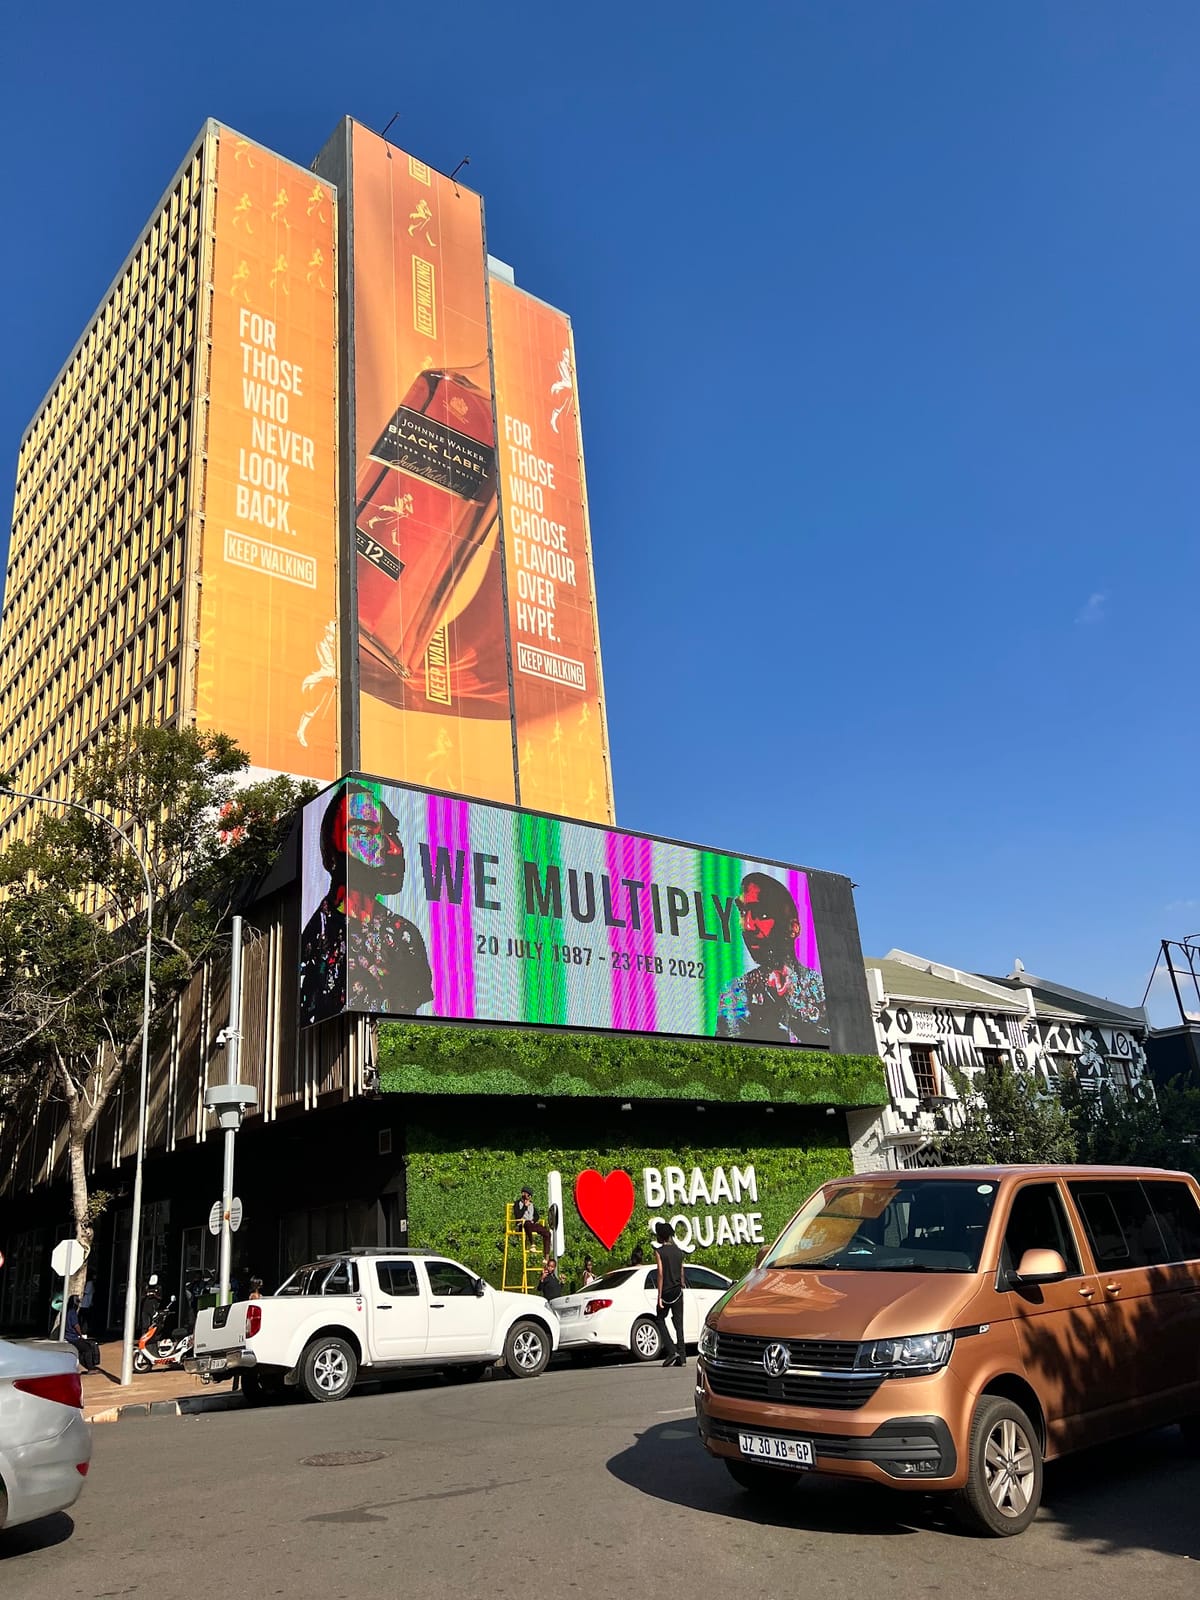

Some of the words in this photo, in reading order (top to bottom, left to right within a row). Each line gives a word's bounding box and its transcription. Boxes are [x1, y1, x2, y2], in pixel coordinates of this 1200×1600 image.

[239, 307, 276, 351] FOR
[240, 342, 304, 396] THOSE
[242, 377, 289, 424] WHO
[251, 416, 315, 471] NEVER
[388, 424, 439, 453] BLACK
[443, 449, 489, 478] LABEL
[402, 418, 445, 443] JOHNNIE
[504, 414, 532, 450] FOR
[239, 448, 290, 497] LOOK
[508, 445, 556, 490] THOSE
[236, 484, 297, 536] BACK.
[509, 474, 544, 514] WHO
[364, 540, 384, 564] 12
[510, 505, 568, 554] CHOOSE
[228, 534, 259, 566] KEEP
[260, 542, 314, 583] WALKING
[514, 538, 576, 587] FLAVOUR
[517, 569, 556, 610] OVER
[516, 600, 561, 642] HYPE.
[430, 666, 448, 700] KEEP
[520, 648, 543, 672] KEEP
[544, 655, 583, 685] WALKING
[419, 842, 501, 912] WE
[523, 861, 734, 944] MULTIPLY
[476, 934, 499, 956] 20
[506, 938, 543, 962] JULY
[552, 944, 593, 967] 1987
[612, 952, 631, 971] 23
[636, 955, 663, 975] FEB
[668, 958, 706, 980] 2022
[643, 1165, 758, 1208] BRAAM
[742, 1435, 754, 1452] JZ
[758, 1438, 770, 1455] 30
[774, 1440, 788, 1457] XB
[796, 1444, 809, 1460] GP
